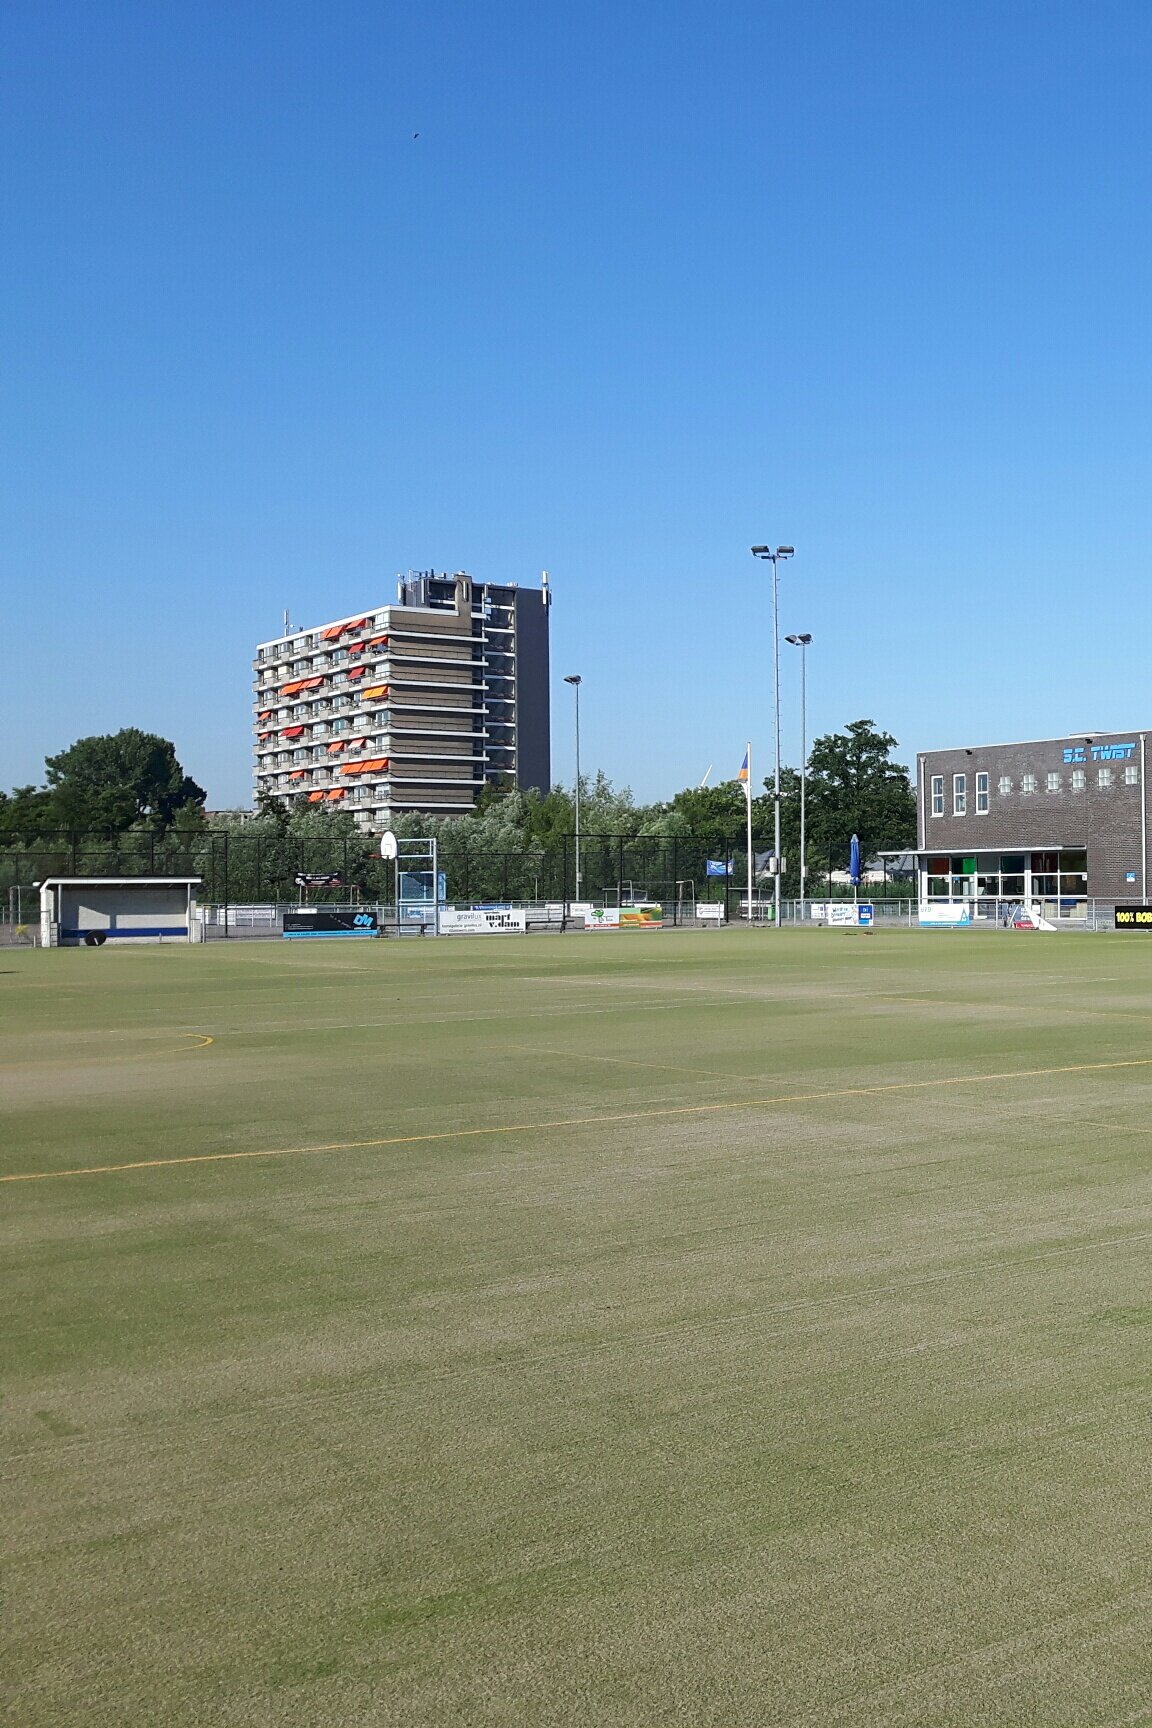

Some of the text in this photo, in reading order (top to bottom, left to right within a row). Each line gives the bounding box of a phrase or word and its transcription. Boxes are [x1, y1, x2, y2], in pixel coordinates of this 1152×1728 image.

[1090, 743, 1136, 761] TWIST
[486, 913, 511, 921] mart
[1116, 912, 1134, 923] 100%
[1135, 912, 1152, 923] BOB
